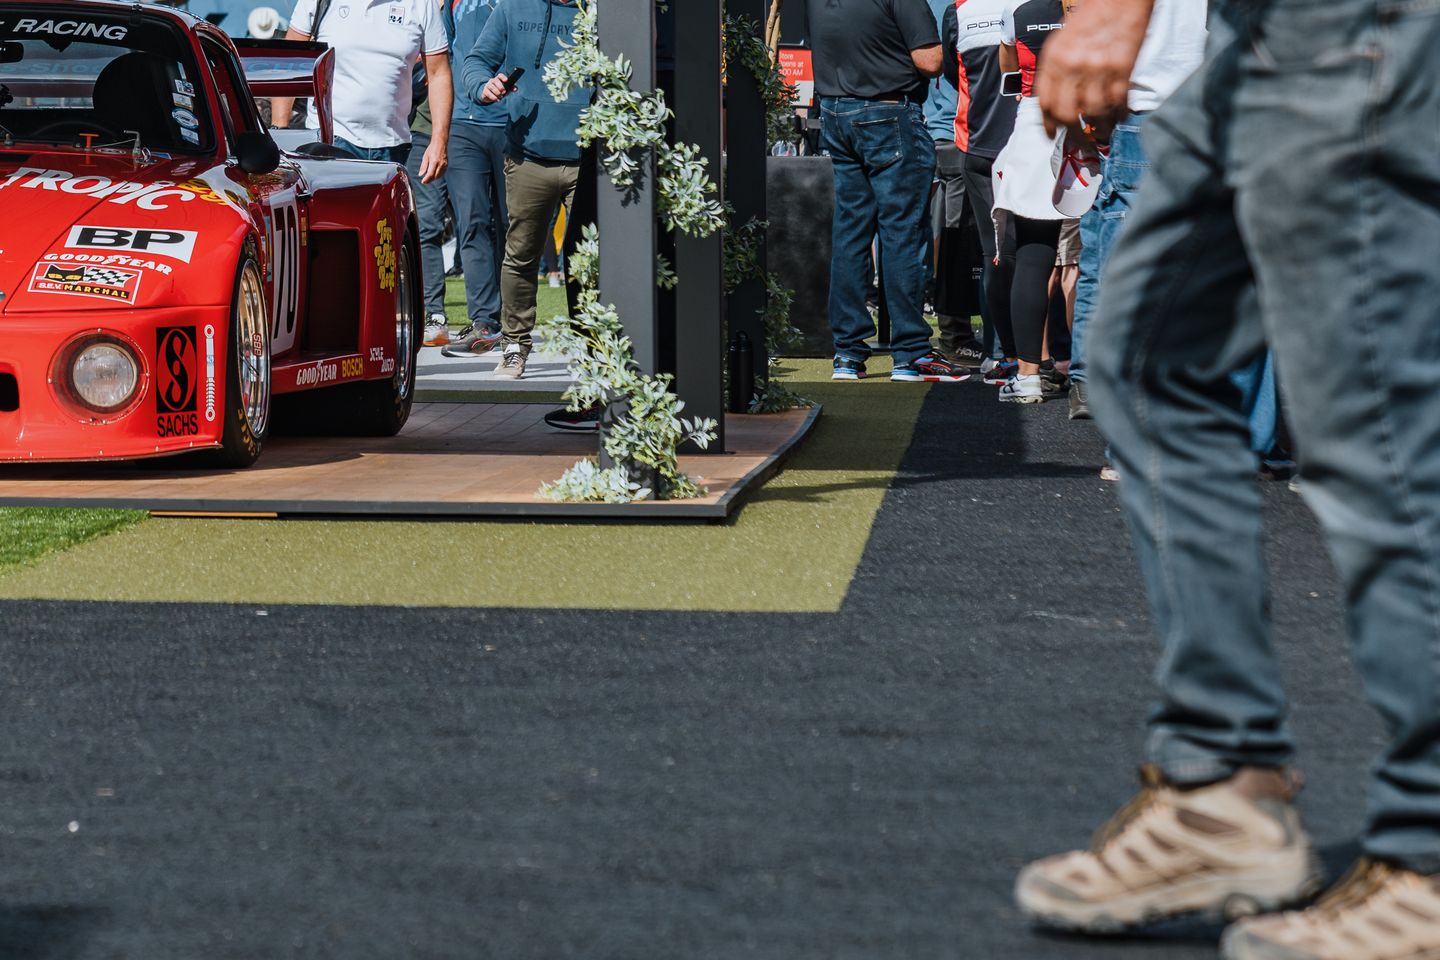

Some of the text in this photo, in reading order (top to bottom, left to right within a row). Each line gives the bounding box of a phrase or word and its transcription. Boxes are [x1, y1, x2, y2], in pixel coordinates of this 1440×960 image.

[12, 18, 128, 40] RACING
[517, 21, 572, 35] SUPEDRY
[76, 227, 185, 250] BP
[43, 252, 173, 276] GOODYEAR
[273, 205, 297, 339] 70
[63, 284, 128, 299] MARCHAL
[296, 357, 364, 386] GOODYEAR BOSCH
[156, 413, 199, 438] SACHS
